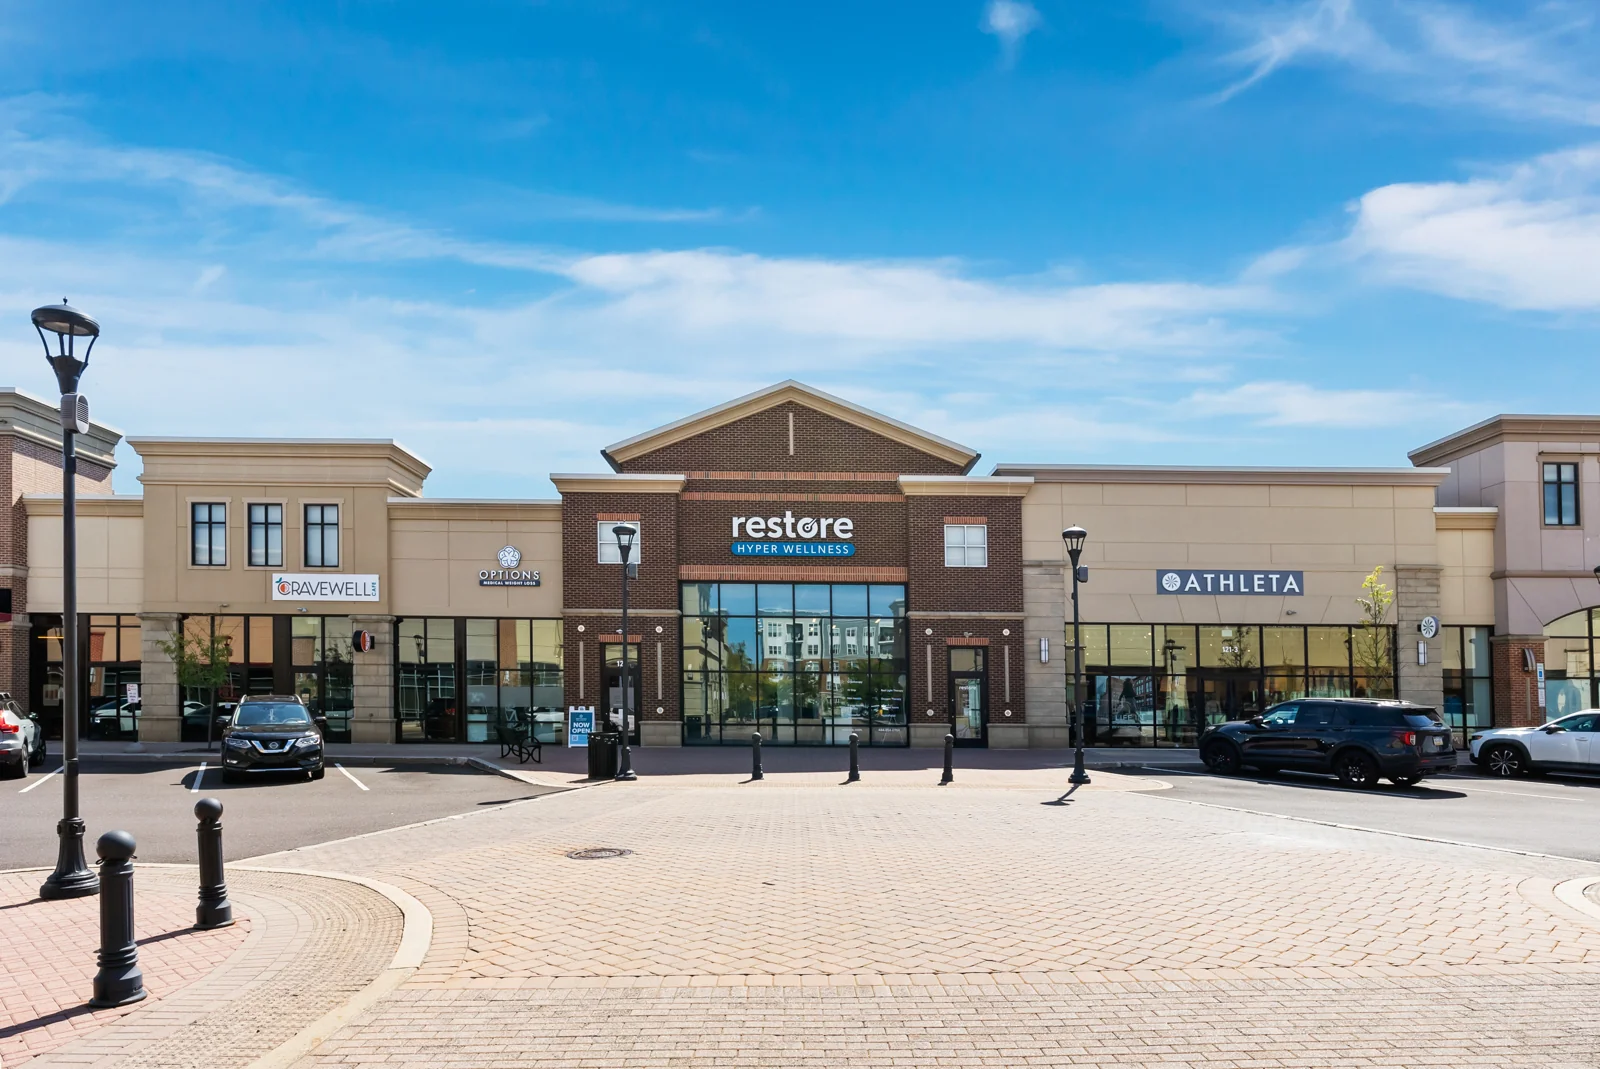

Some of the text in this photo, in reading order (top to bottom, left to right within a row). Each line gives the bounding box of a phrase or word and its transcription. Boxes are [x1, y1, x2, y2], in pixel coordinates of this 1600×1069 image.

[732, 510, 854, 539] restore
[737, 544, 849, 555] HYPER WELLNESS
[479, 570, 540, 580] OPTIONS
[1184, 573, 1300, 593] ATHLETA
[277, 580, 371, 597] CRAVEWELL
